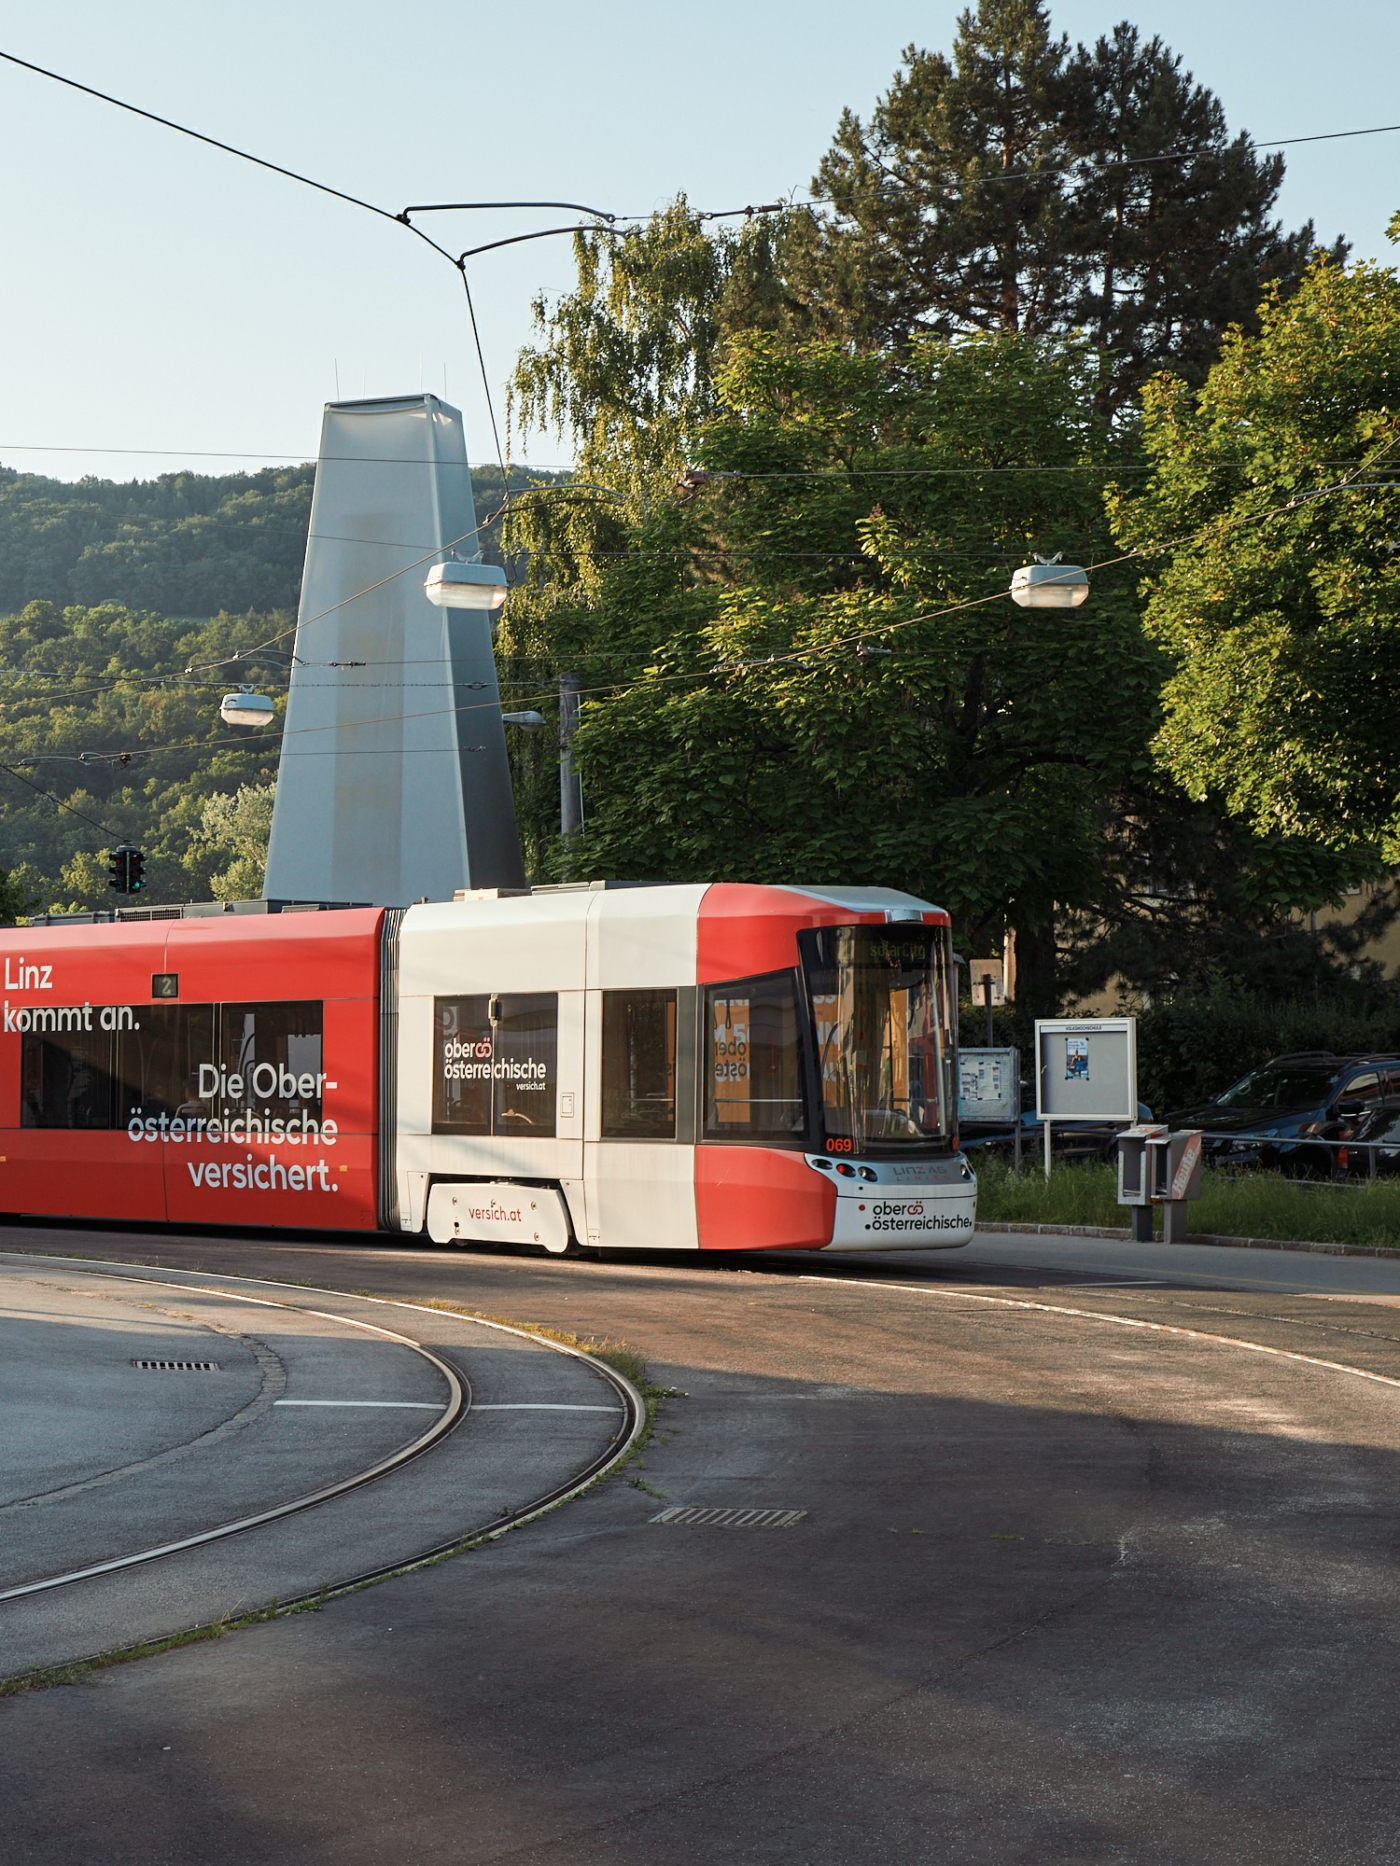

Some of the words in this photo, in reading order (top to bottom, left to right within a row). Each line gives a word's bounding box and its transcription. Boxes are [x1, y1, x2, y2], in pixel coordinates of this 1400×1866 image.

[4, 956, 53, 990] Linz
[161, 977, 172, 995] 2
[3, 1000, 93, 1032] kommt
[100, 1005, 140, 1031] an.
[198, 1063, 244, 1099] Die
[252, 1062, 338, 1099] Ober-
[444, 1058, 546, 1079] österreichische
[515, 1081, 546, 1091] versich.at
[127, 1107, 338, 1145] österreichische
[826, 1138, 852, 1152] 069
[187, 1154, 339, 1192] versichert.
[468, 1205, 522, 1222] versich.at
